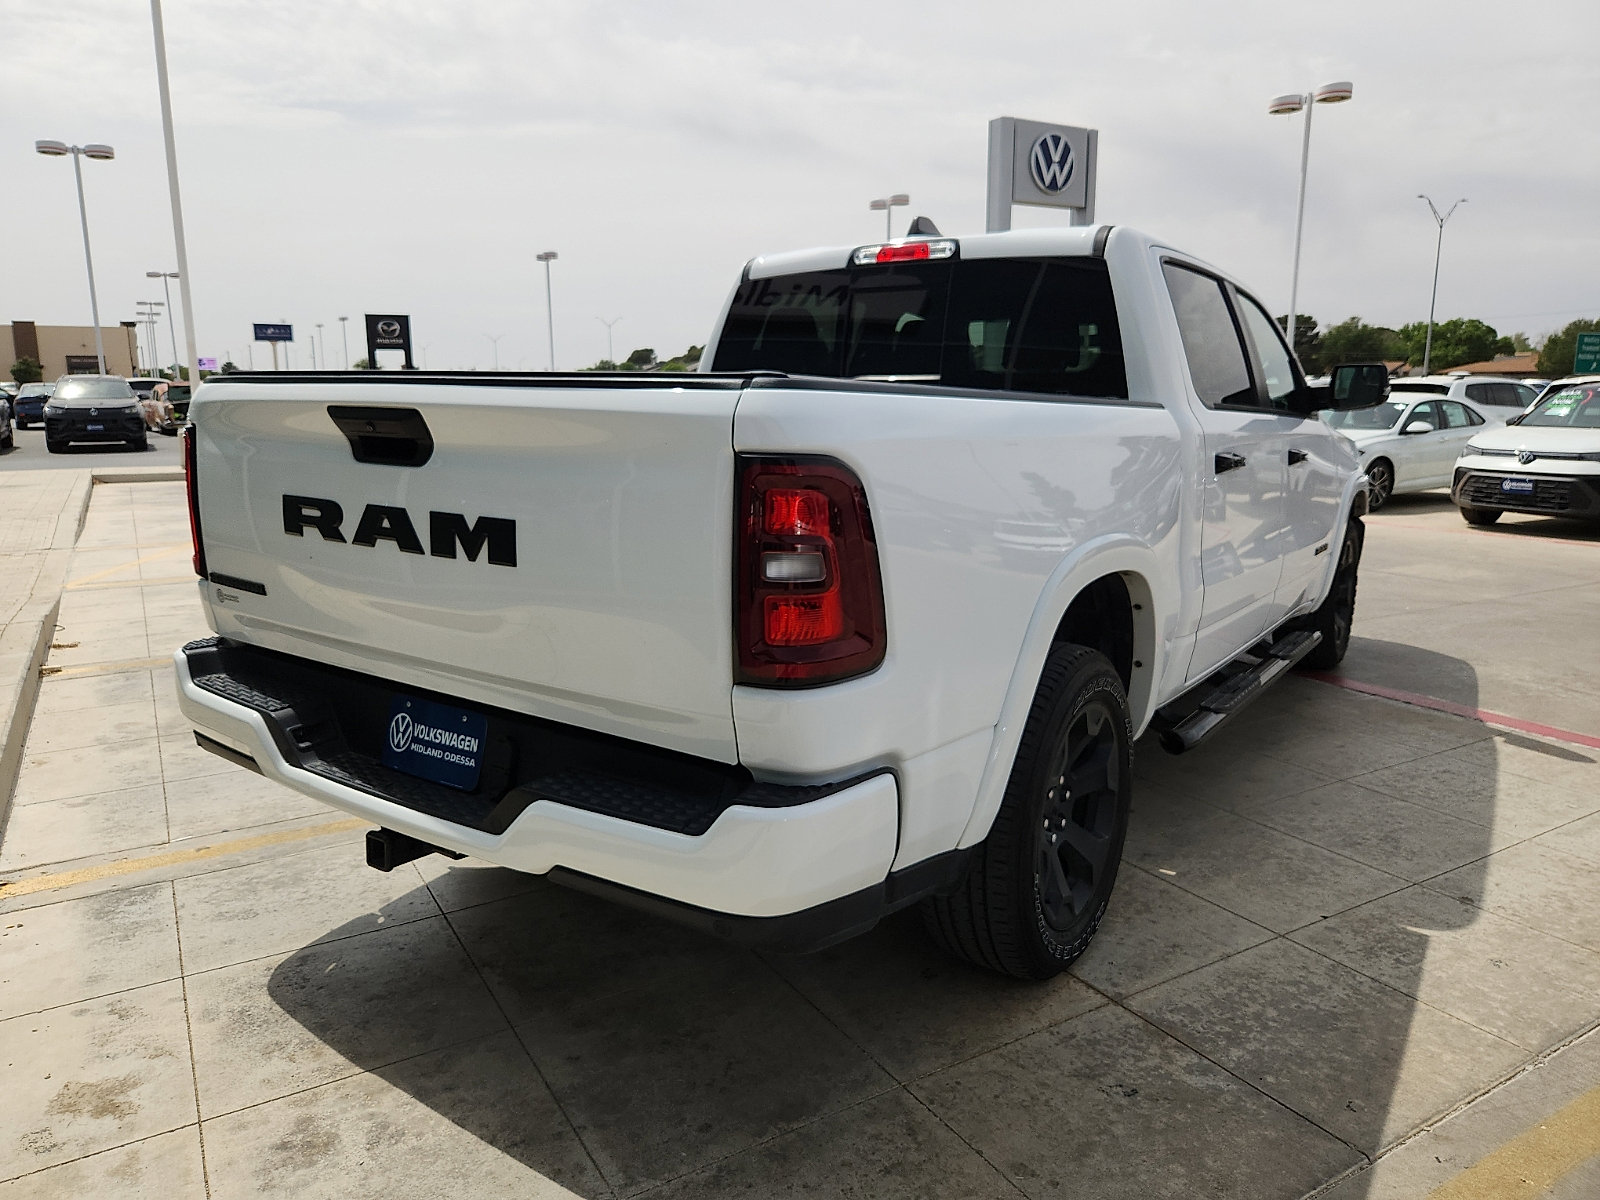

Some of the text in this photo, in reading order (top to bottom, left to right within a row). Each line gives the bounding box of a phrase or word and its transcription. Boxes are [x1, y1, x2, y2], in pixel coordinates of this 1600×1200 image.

[282, 494, 518, 567] RAM
[414, 722, 479, 753] VOLKSWAGEN
[410, 742, 476, 768] MIDLAND ODESSA
